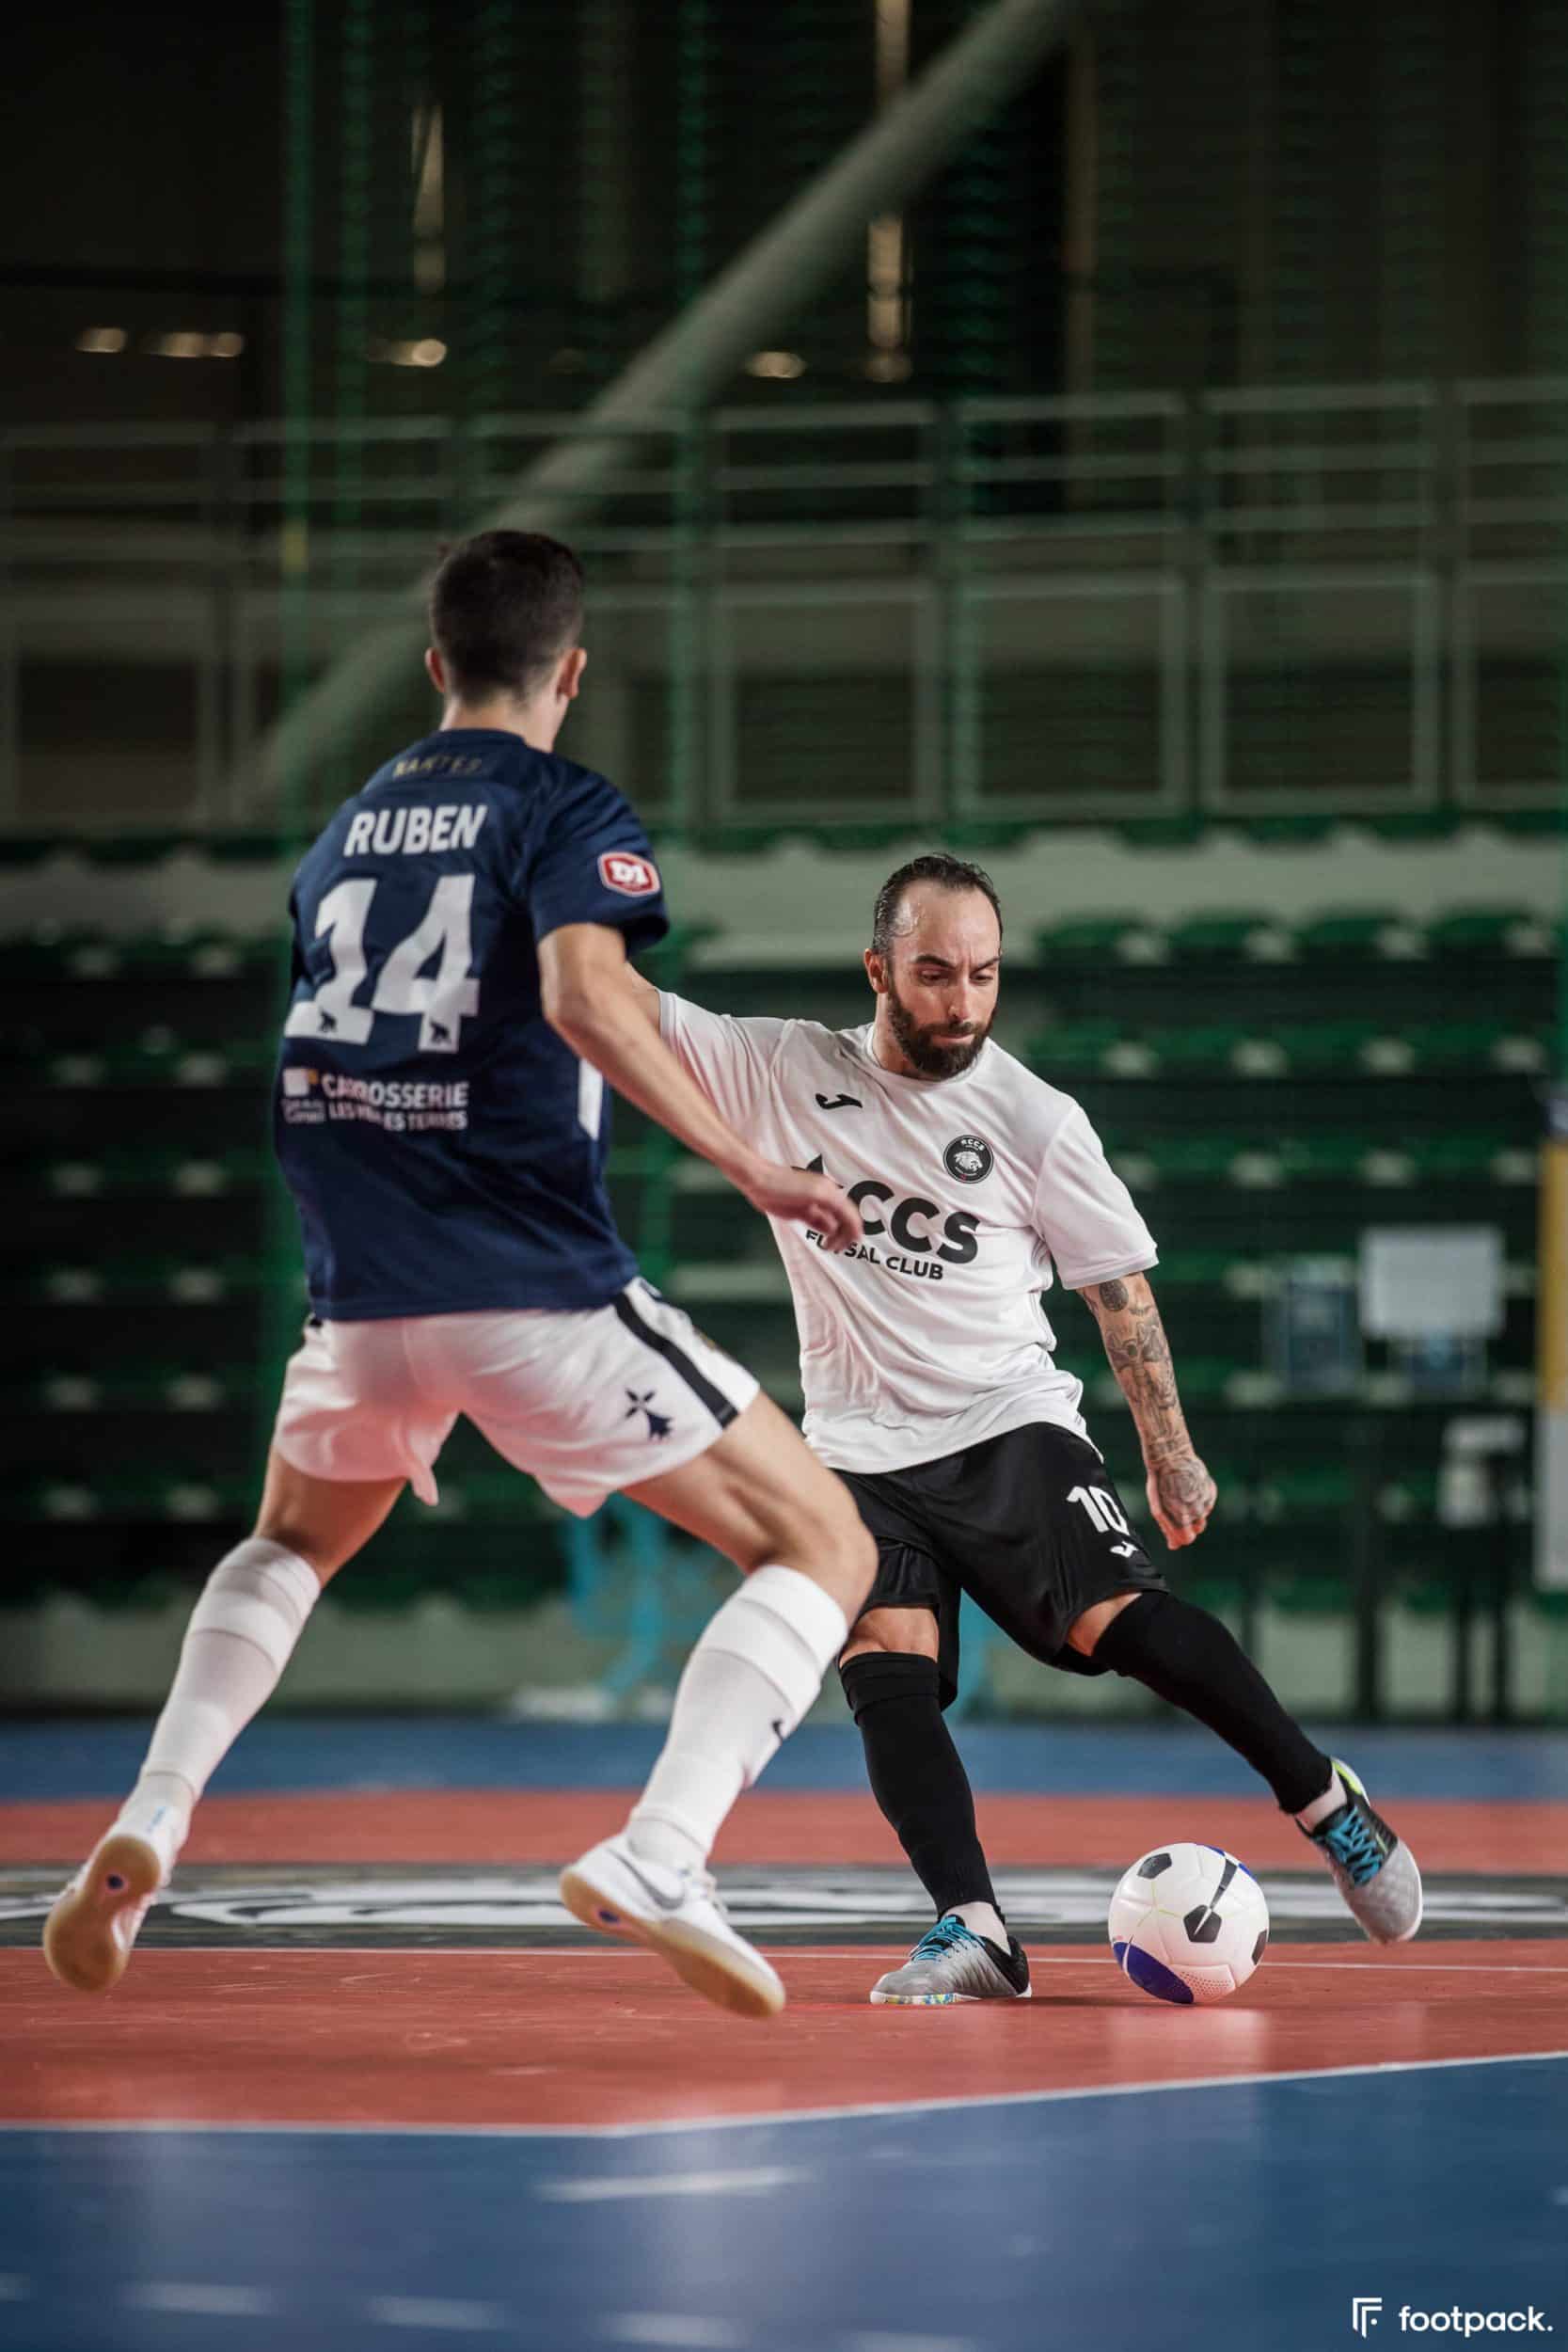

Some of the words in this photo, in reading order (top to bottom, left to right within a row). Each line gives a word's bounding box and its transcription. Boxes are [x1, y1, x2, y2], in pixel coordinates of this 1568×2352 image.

[343, 804, 487, 856] RUBEN
[285, 874, 480, 1053] 14
[805, 1229, 881, 1264] FUSAL
[886, 1256, 943, 1280] CLUB
[1066, 1486, 1130, 1536] 10
